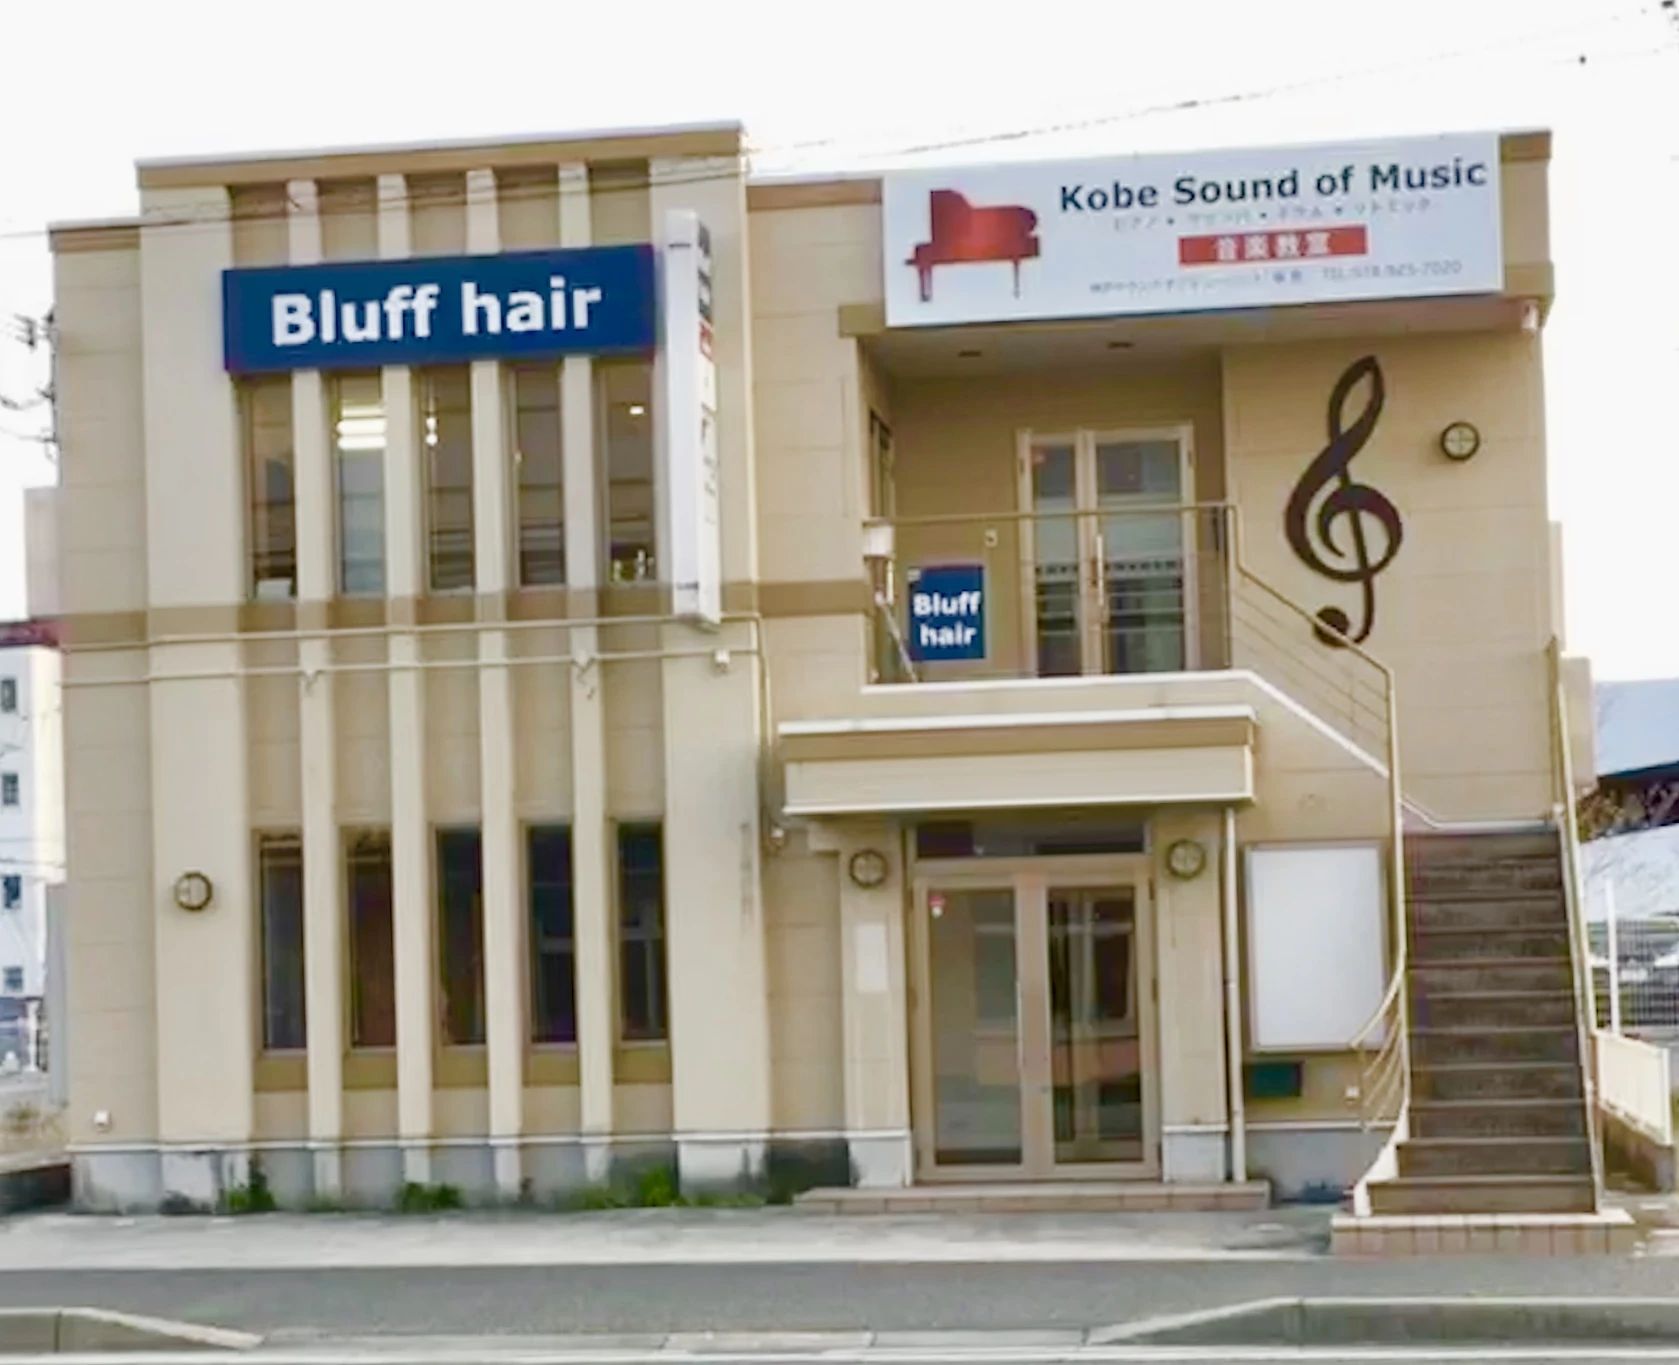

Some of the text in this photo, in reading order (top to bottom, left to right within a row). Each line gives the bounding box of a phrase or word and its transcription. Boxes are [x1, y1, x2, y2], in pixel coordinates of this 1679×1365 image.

[1060, 156, 1489, 212] Kobe Sound of Music
[272, 275, 602, 347] Bluff hair
[913, 590, 982, 617] Bluff
[920, 621, 978, 647] hair
